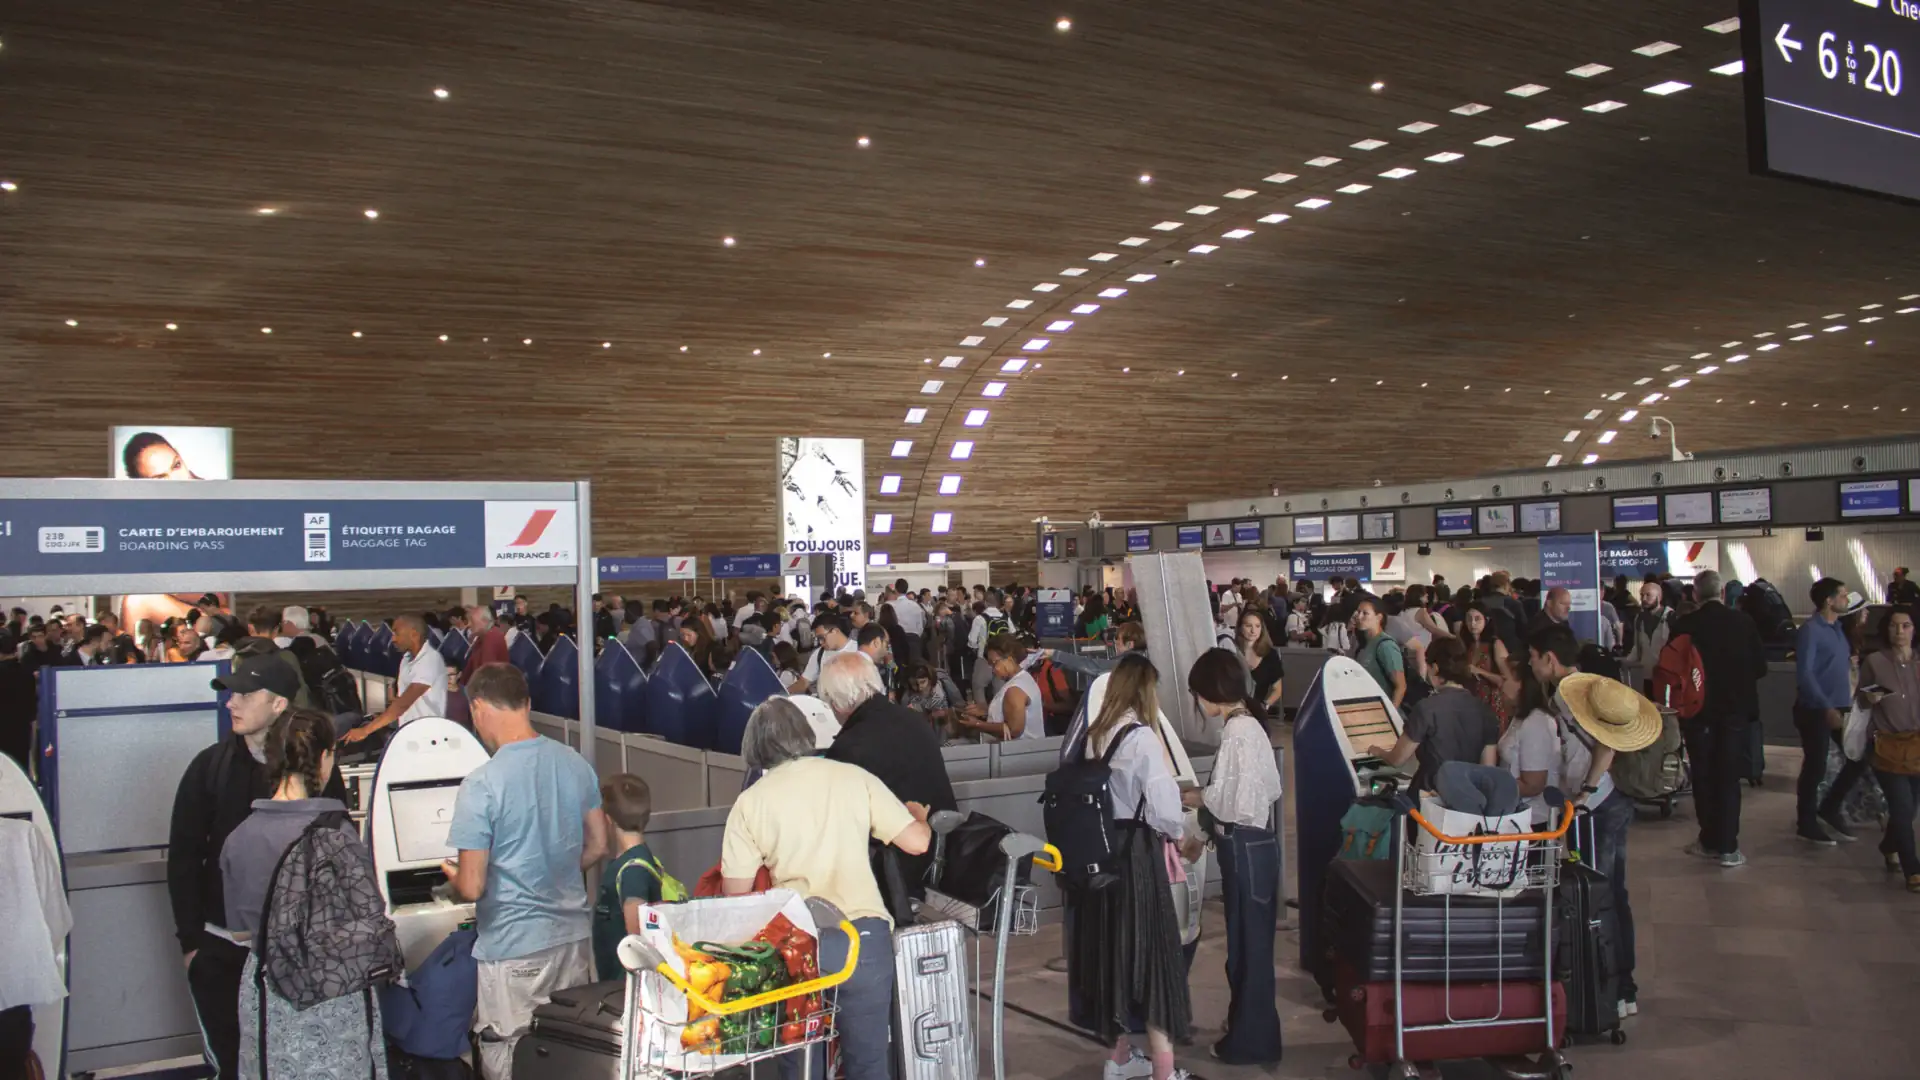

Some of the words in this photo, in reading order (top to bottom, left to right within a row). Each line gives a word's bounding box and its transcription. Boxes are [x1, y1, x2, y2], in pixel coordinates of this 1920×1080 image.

[1890, 0, 1920, 20] Che
[1818, 32, 1838, 79] 6
[1863, 44, 1901, 96] 20
[1845, 56, 1857, 70] to
[309, 516, 325, 525] AF
[119, 527, 163, 537] CARTE
[342, 525, 404, 535] ÉTIQUETTE
[407, 525, 457, 535] BAGAGE
[119, 541, 190, 551] BOARDING
[193, 540, 225, 550] PASS
[342, 538, 400, 548] BAGGAGE
[404, 537, 427, 547] TAG
[788, 540, 861, 552] TOUJOURS
[1045, 539, 1052, 553] 4
[1609, 549, 1648, 557] BAGAGES
[1618, 557, 1659, 566] DROP-OFF
